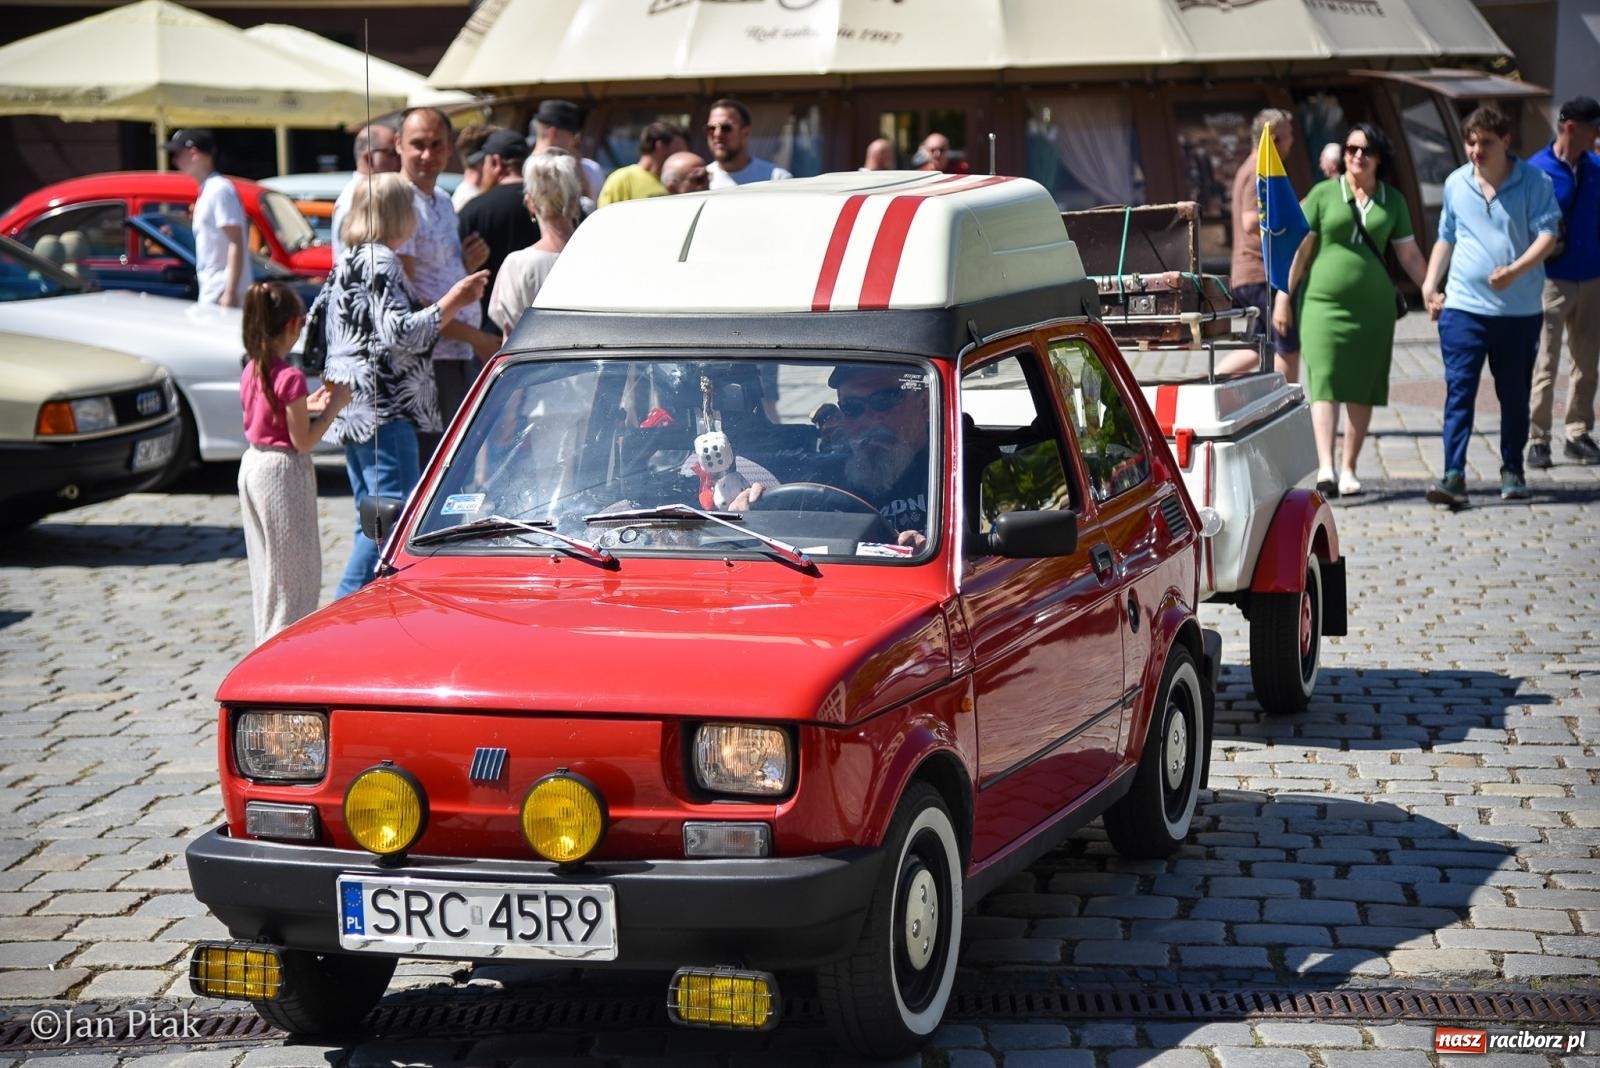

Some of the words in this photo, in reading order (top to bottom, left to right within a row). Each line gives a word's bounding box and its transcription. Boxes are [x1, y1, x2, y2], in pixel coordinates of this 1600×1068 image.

[346, 916, 362, 930] PL
[371, 888, 469, 938] SRC
[488, 892, 602, 943] 45R9
